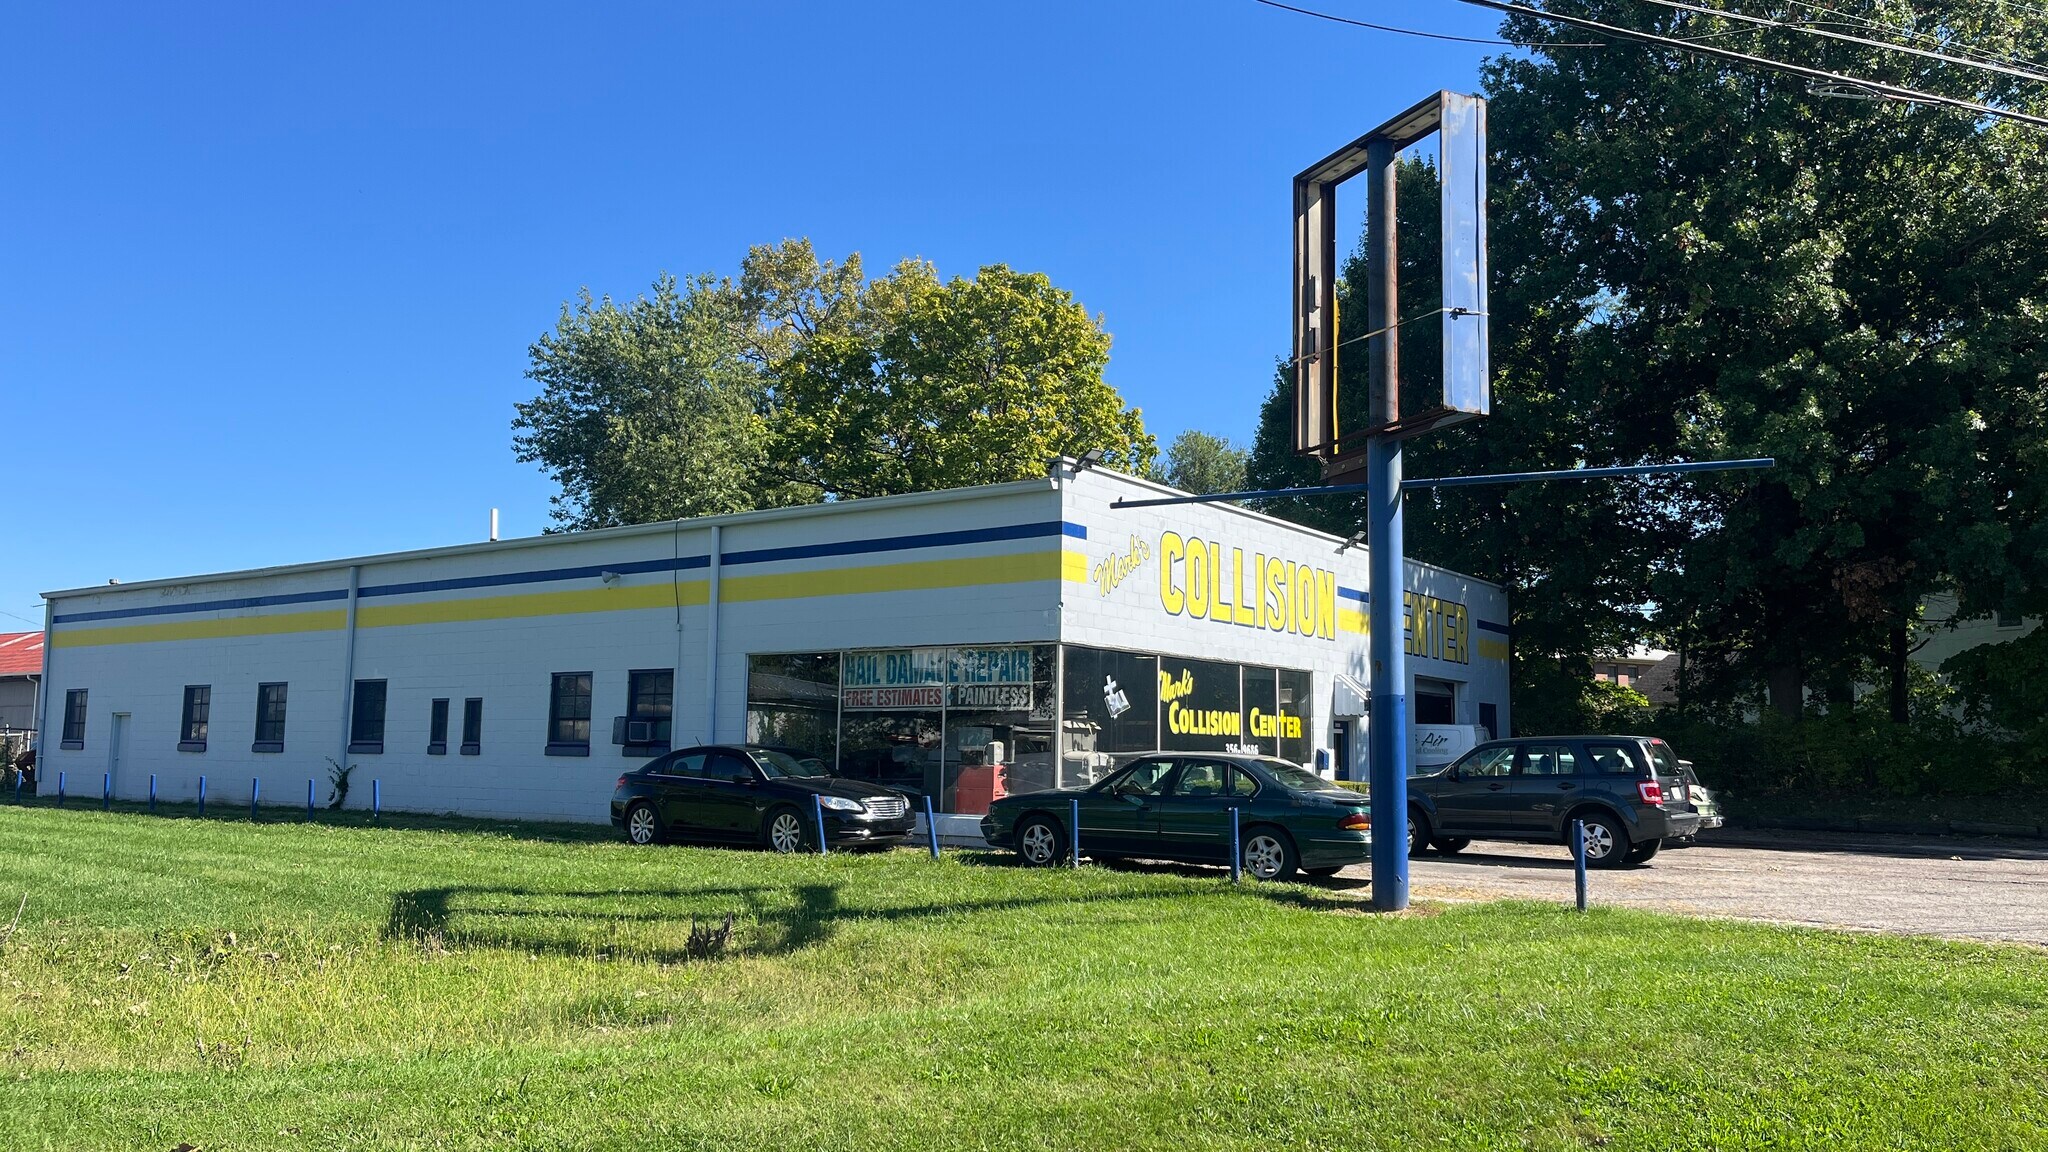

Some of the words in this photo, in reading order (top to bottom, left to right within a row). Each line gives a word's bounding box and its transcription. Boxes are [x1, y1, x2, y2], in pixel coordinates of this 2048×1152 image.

[1093, 533, 1150, 597] Mark's
[1160, 531, 1335, 641] COLLISION
[1403, 590, 1469, 665] ENTER
[844, 655, 881, 686] HAIL
[965, 649, 1030, 683] REPAIR
[845, 689, 874, 706] FREE
[877, 688, 942, 706] ESTIMATES
[958, 686, 1028, 706] PAINTLESS
[1159, 668, 1194, 703] Mark's
[1168, 700, 1240, 736] COLLISION
[1421, 732, 1448, 747] Air
